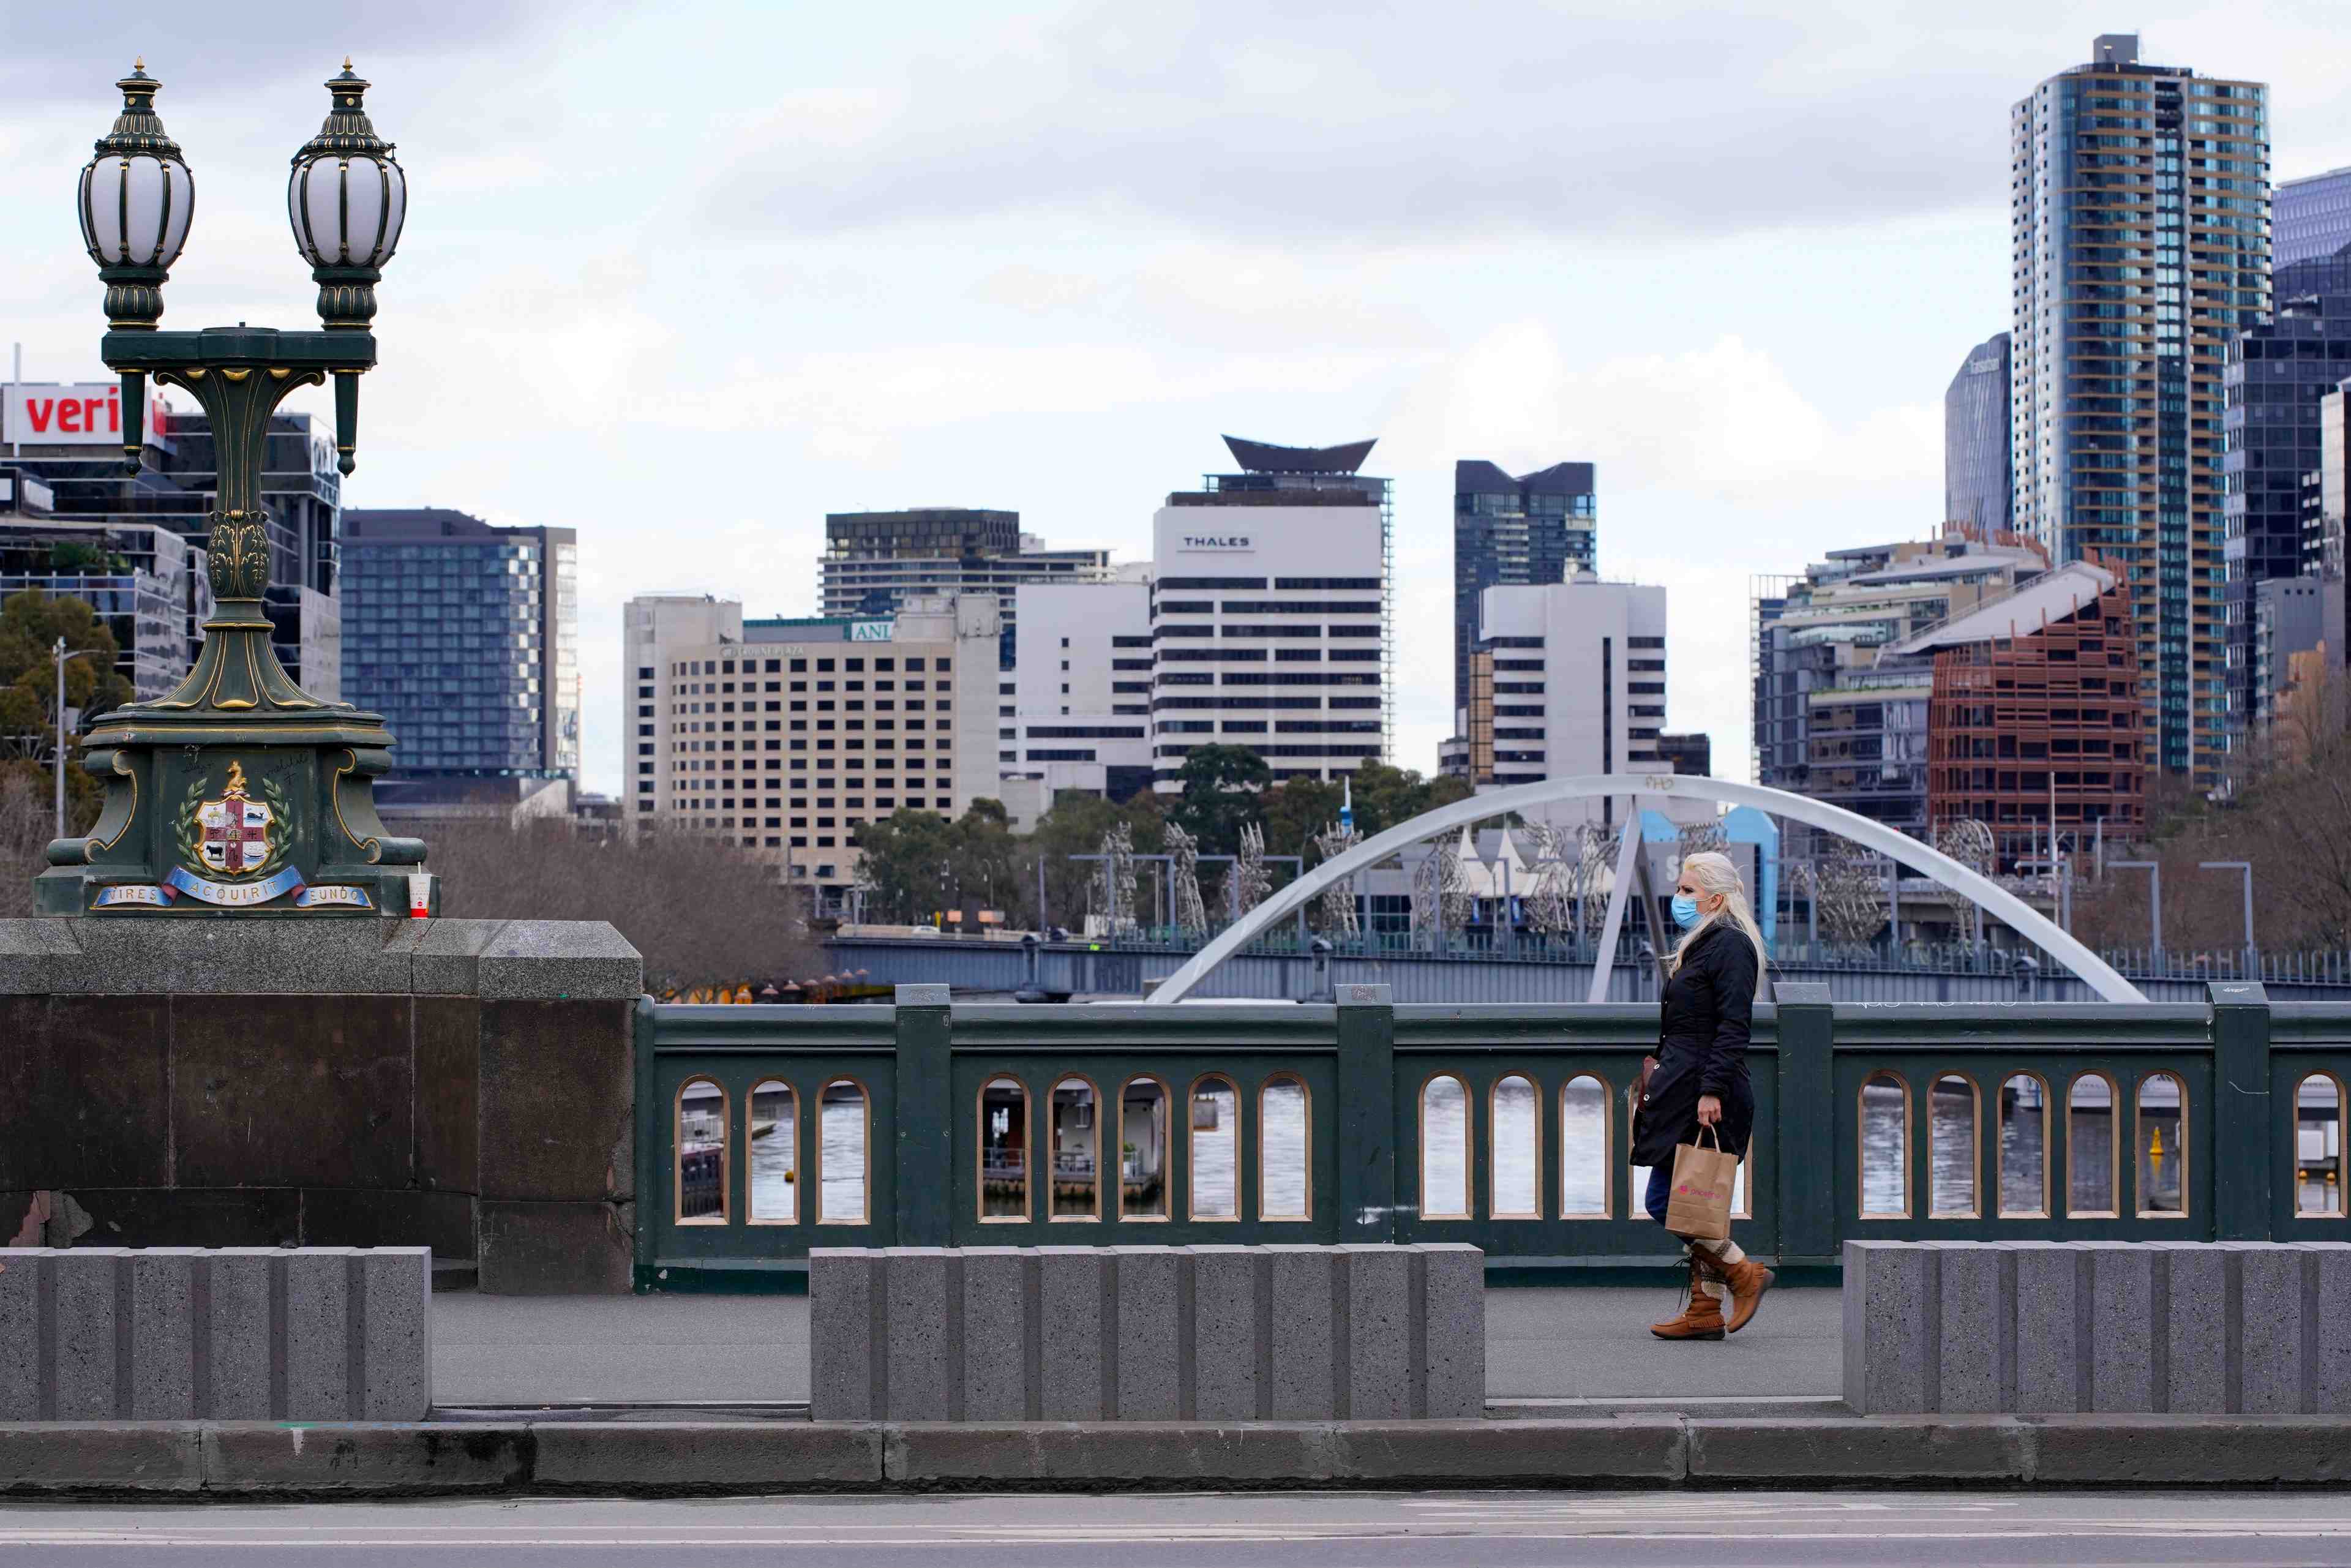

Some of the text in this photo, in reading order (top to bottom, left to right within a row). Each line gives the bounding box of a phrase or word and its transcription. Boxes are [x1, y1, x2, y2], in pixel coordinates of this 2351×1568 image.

[26, 386, 145, 432] veri
[1183, 537, 1250, 547] THALES
[108, 882, 358, 901] VIRES ACQUIRIT EUNDO
